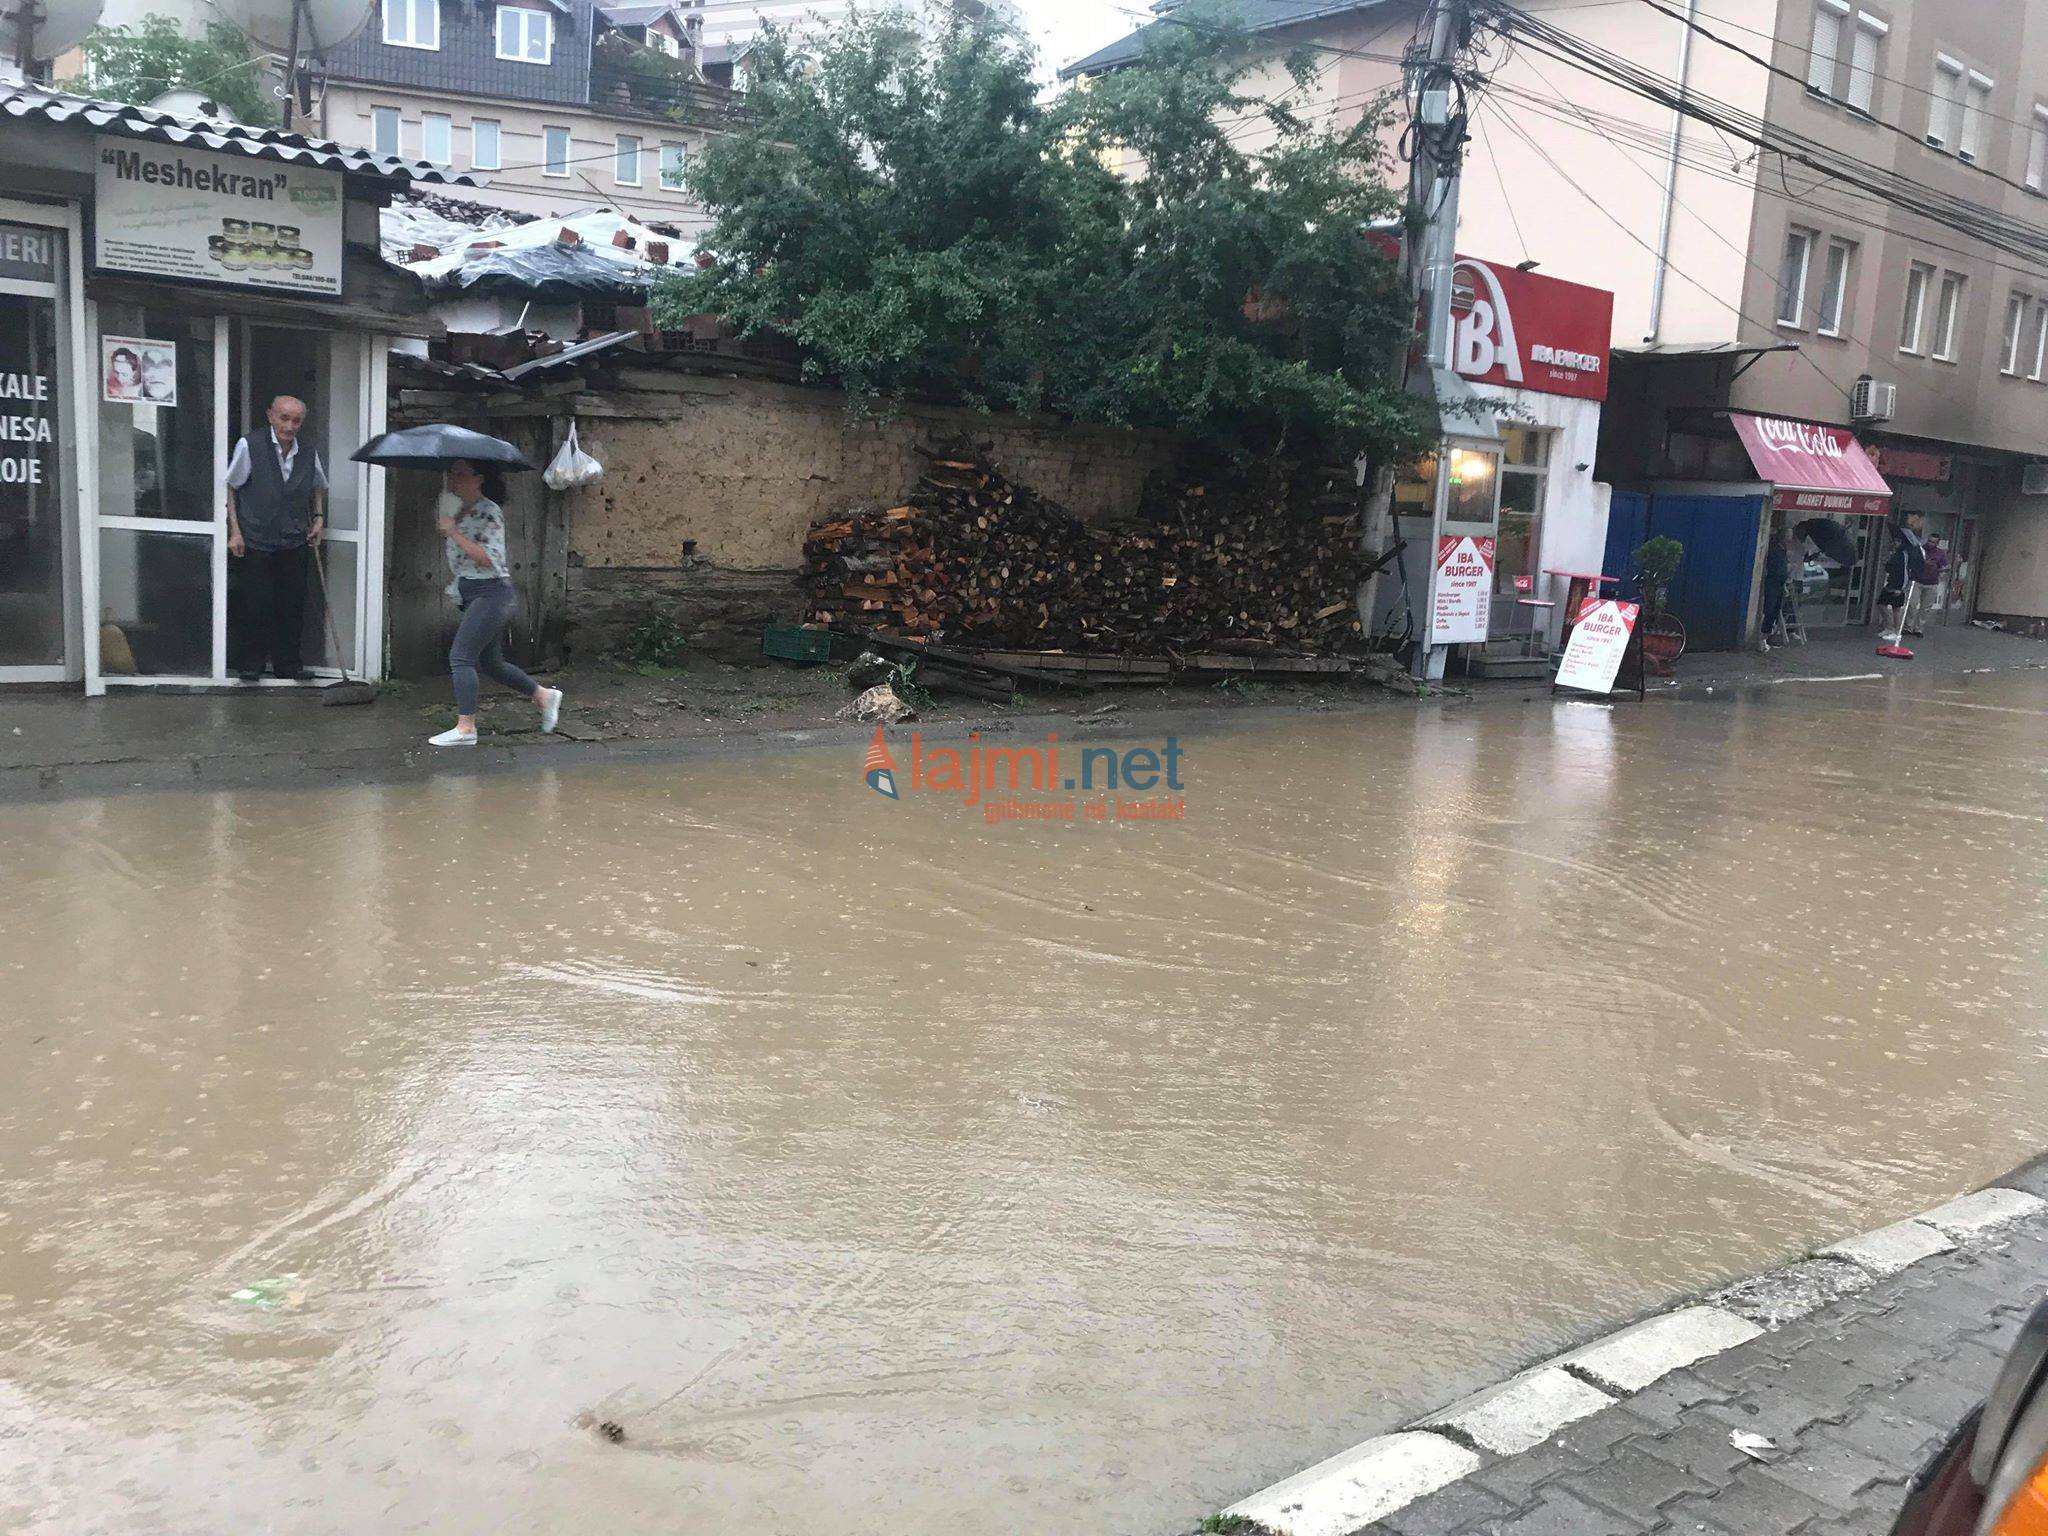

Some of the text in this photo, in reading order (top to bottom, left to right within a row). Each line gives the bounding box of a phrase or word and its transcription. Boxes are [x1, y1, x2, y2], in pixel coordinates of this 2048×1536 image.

[0, 232, 48, 265] ERI
[1555, 349, 1600, 373] BURGER
[0, 457, 42, 484] OJE
[1796, 493, 1824, 507] MARKET
[1457, 553, 1474, 563] IBA
[1444, 566, 1484, 577] BURGER
[1598, 613, 1614, 623] IBA
[1583, 622, 1622, 636] BURGER
